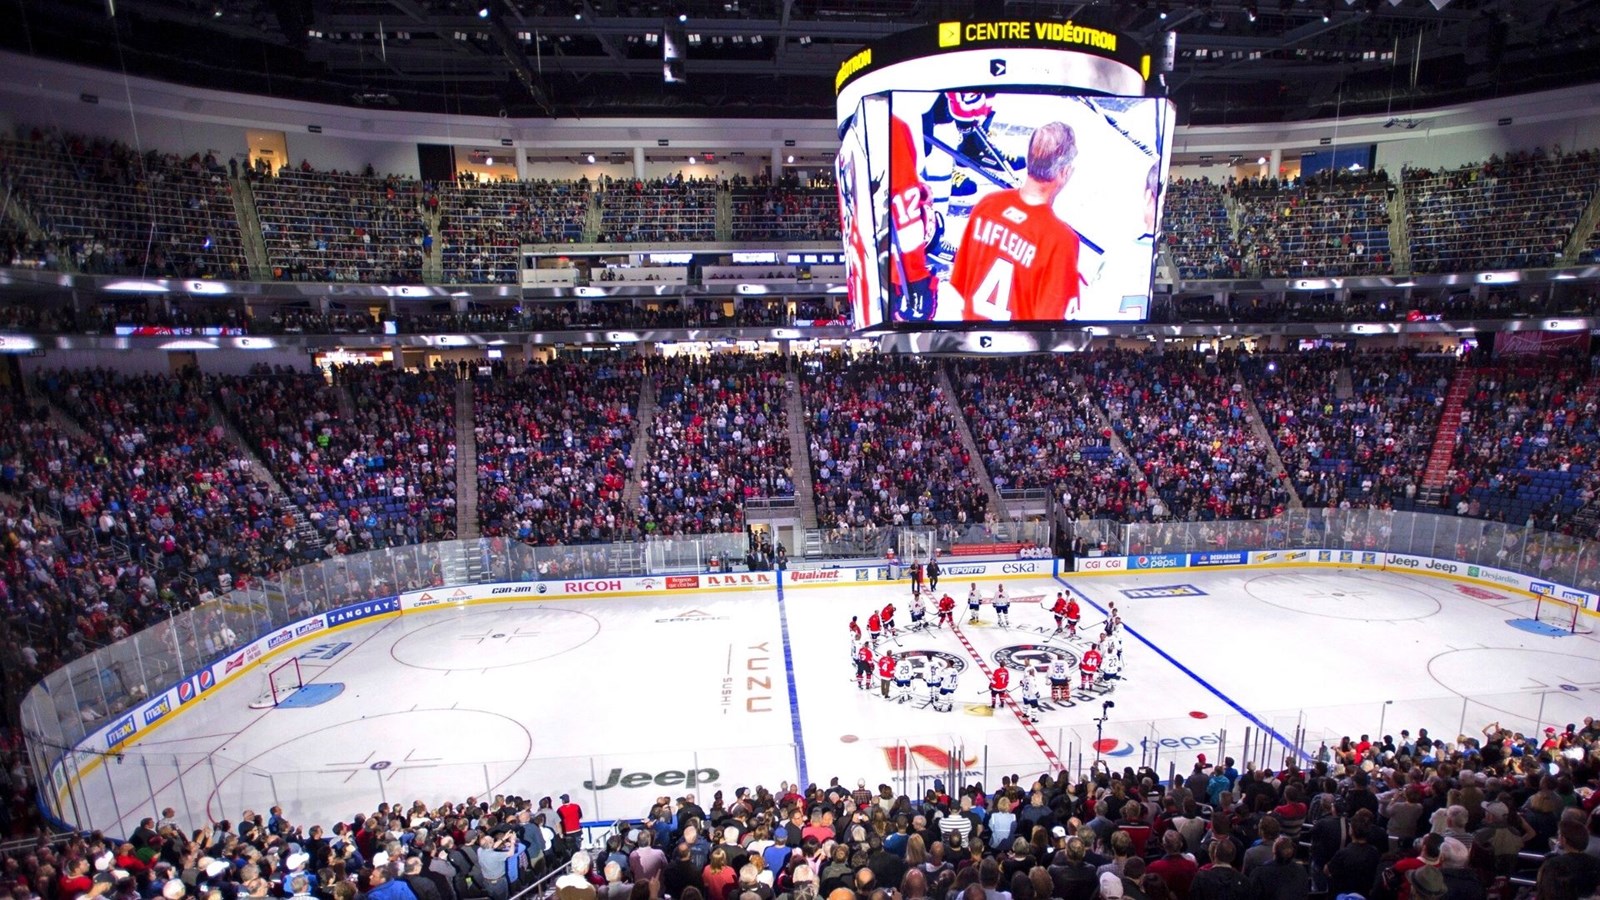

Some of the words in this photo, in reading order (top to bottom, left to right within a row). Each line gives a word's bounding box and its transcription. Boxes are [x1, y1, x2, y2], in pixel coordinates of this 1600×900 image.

[966, 22, 1030, 41] CENTRE
[1036, 20, 1117, 52] VIDÉOTRON
[892, 187, 922, 225] 12
[975, 217, 1037, 268] LAFLEUR
[973, 258, 1015, 321] 4
[1003, 563, 1035, 573] eska
[1150, 557, 1177, 569] pepsi
[1387, 555, 1419, 568] Jeep
[1425, 559, 1457, 573] Jeep
[950, 566, 985, 574] SPORTS
[1481, 570, 1520, 585] Desjardins
[492, 586, 531, 594] can-am
[565, 580, 621, 592] RICOH
[1131, 585, 1199, 598] maxi
[1531, 583, 1554, 595] maxi
[1564, 592, 1588, 604] maxi
[330, 602, 390, 623] TANGUAY
[1086, 658, 1098, 667] 44
[900, 665, 909, 674] 29
[1055, 665, 1064, 674] 35
[746, 641, 773, 713] YUZU
[1000, 674, 1006, 684] 7
[721, 677, 733, 706] SUSHI
[146, 697, 169, 721] maxi
[108, 718, 135, 744] maxi
[1140, 732, 1223, 752] pepsi
[583, 768, 720, 791] Jeep
